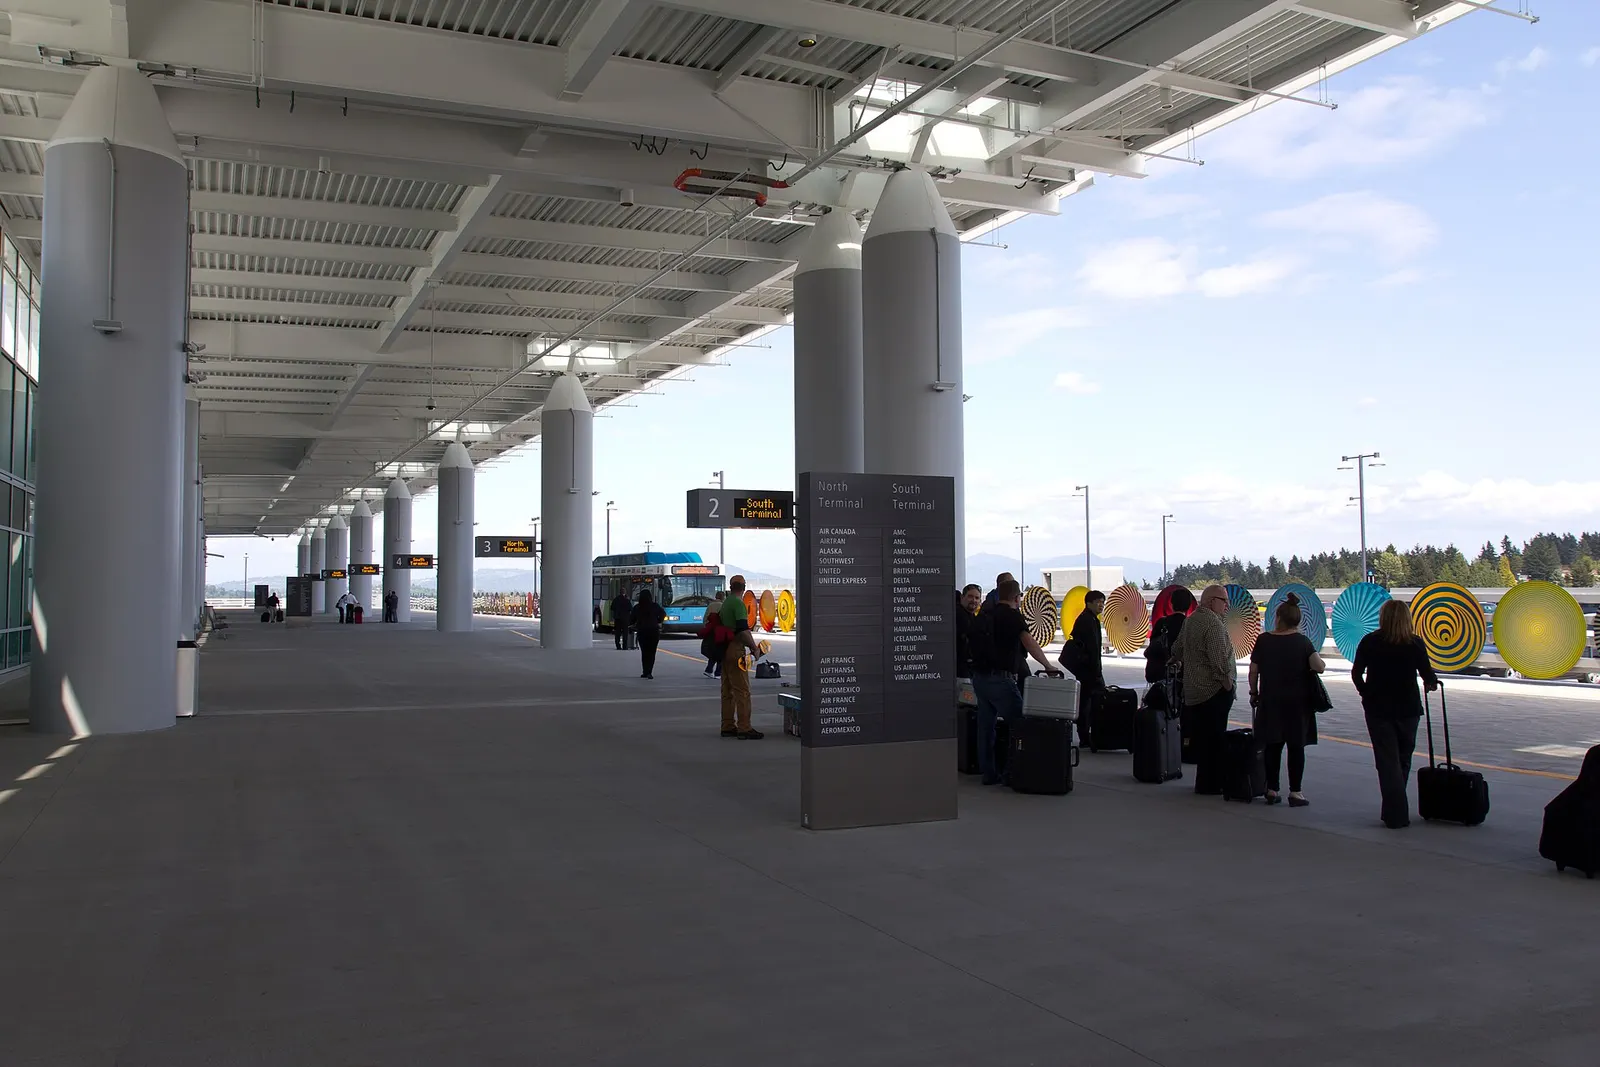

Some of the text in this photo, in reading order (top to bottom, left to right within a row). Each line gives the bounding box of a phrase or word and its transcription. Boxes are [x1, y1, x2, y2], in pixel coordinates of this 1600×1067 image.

[818, 481, 848, 492] North
[892, 483, 920, 494] South
[746, 498, 774, 508] South
[818, 497, 863, 509] Terminal
[893, 499, 935, 510] Terminal
[709, 498, 719, 518] 2
[740, 507, 782, 518] Terminal
[819, 527, 856, 535] AIR CANADA
[819, 537, 846, 545] AIRTRAN
[483, 540, 491, 552] 3
[818, 547, 843, 555] ALASKA
[396, 557, 402, 566] 4
[819, 557, 855, 565] SOUTHWEST
[893, 557, 915, 565] ASIANA
[818, 567, 841, 575] UNITED
[893, 567, 941, 575] BRITISH AIRWAYS
[818, 577, 867, 585] UNITED EXPRESS
[893, 586, 921, 594] EMIRATES
[893, 596, 916, 604] EVA AIR
[893, 615, 942, 623] HAINAN AIRLINES
[893, 634, 927, 642] ICELANDAIR
[894, 644, 917, 652] JETBLUE
[820, 656, 855, 664] AIR FRANCE
[894, 653, 934, 662] SUN COUNTRY
[820, 666, 855, 674] LUFTHANSA
[893, 663, 928, 671] US AIRWAYS
[820, 676, 857, 684] KOREAN AIR
[894, 672, 941, 681] VIRGIN AMERICA
[821, 686, 861, 694] AEROMEXICO
[820, 696, 856, 704] AIR FRANCE
[820, 706, 847, 714] HORIZON
[820, 716, 855, 724] LUFTHANSA
[821, 726, 861, 734] AEROMEXICO
